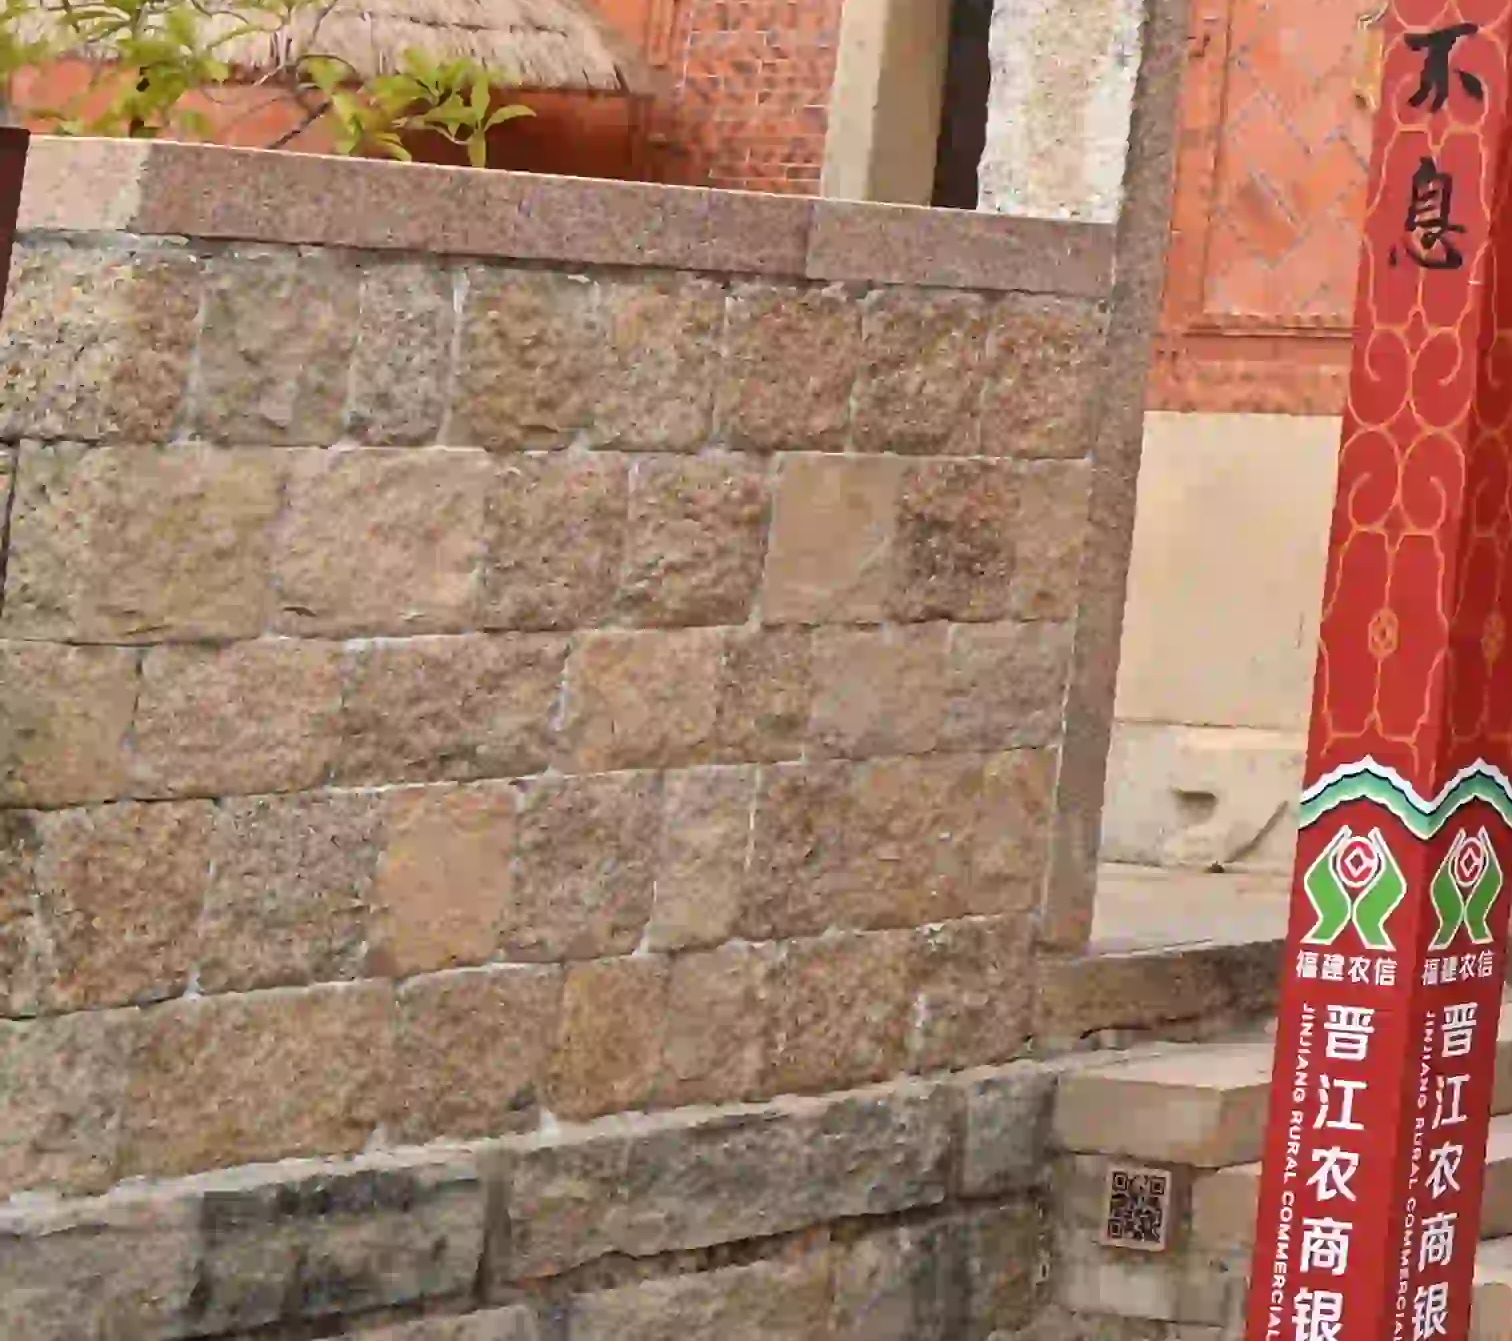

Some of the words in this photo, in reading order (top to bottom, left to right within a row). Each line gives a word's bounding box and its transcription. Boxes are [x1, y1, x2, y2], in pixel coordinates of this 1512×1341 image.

[1296, 950, 1397, 986] 福建农信
[1421, 950, 1496, 987] 福建农信
[1292, 1003, 1315, 1102] JINJIANG
[1417, 1011, 1436, 1108] JINJIANG
[1283, 1110, 1304, 1183] RURAL
[1292, 1004, 1374, 1341] 晋江农商银
[1408, 1117, 1425, 1189] RURAL
[1411, 1002, 1477, 1341] 晋江农商银
[1266, 1191, 1295, 1341] COMMERCIAL
